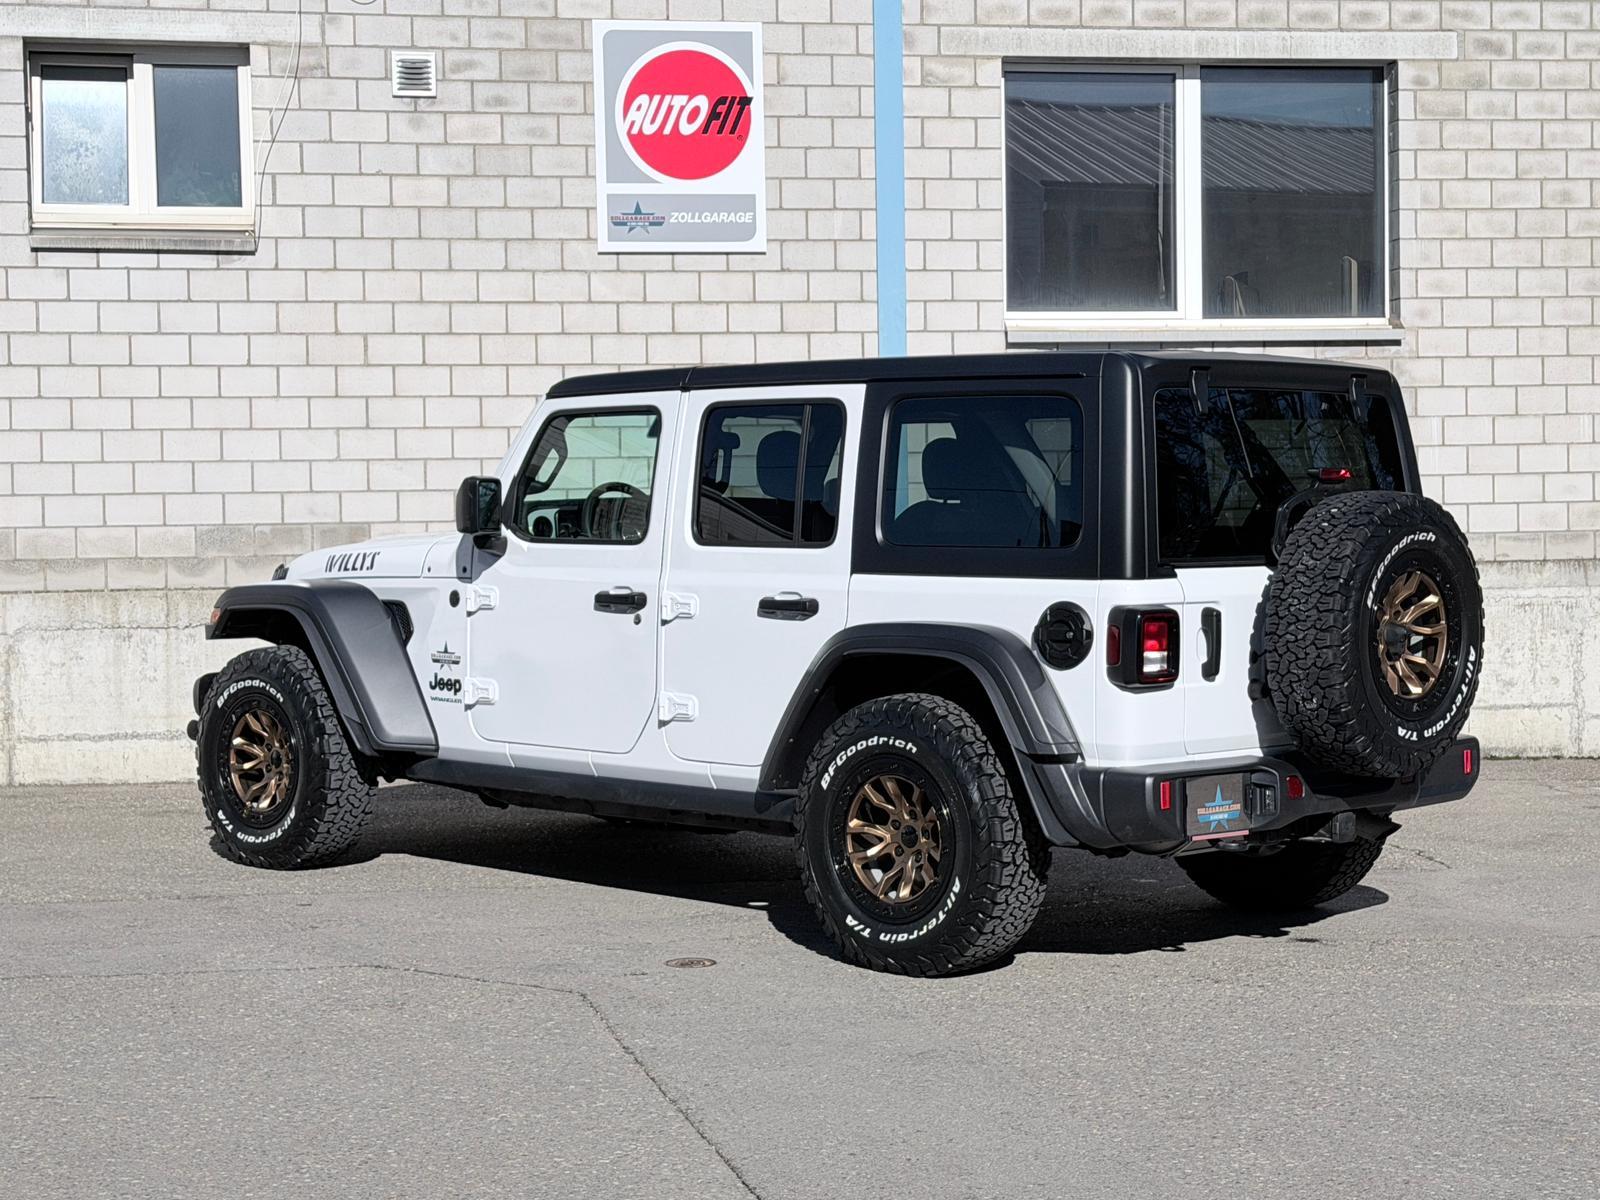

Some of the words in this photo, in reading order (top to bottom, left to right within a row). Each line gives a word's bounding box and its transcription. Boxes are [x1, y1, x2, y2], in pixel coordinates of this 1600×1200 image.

[670, 212, 754, 223] ZOLLGARAGE
[325, 551, 381, 573] WILLYS
[1366, 531, 1436, 609] BFGoodrich
[217, 679, 284, 709] BFGoodrich
[429, 672, 462, 696] Jeep
[430, 696, 462, 704] WRANGLER
[1397, 725, 1418, 741] T/A
[820, 735, 918, 791] BFGoodrich
[217, 809, 234, 832] T/A
[879, 875, 961, 943] All-Terrain
[844, 914, 872, 938] T/A
